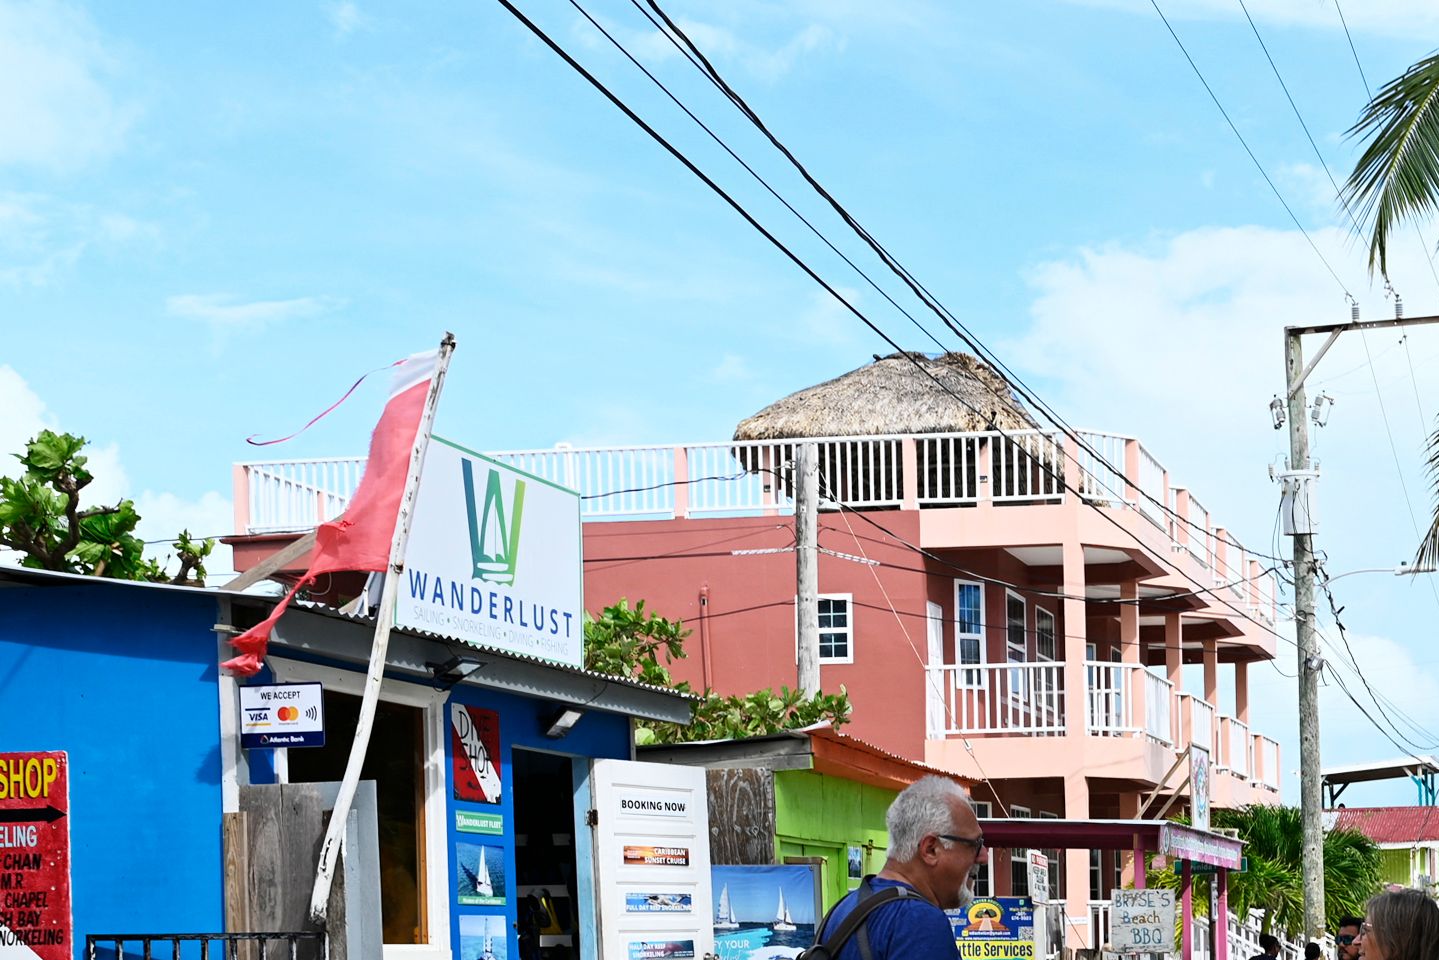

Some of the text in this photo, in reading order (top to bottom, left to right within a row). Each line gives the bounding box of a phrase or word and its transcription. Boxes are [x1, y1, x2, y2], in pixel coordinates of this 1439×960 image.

[408, 568, 573, 639] WANDERLUST
[414, 606, 569, 656] SAILING SNORKELING DIVING FISHING
[260, 690, 301, 700] WE ACCEPT
[249, 712, 268, 721] VISA
[0, 757, 57, 799] SHOP
[621, 799, 686, 812] BOOKING NOW
[666, 857, 686, 865] CRUISE
[5, 890, 49, 909] CHAPEL
[18, 910, 42, 927] BAY
[1122, 910, 1161, 925] Beach
[1131, 927, 1162, 945] BBQ
[725, 939, 750, 949] YOUR
[959, 942, 1033, 957] ttle Services
